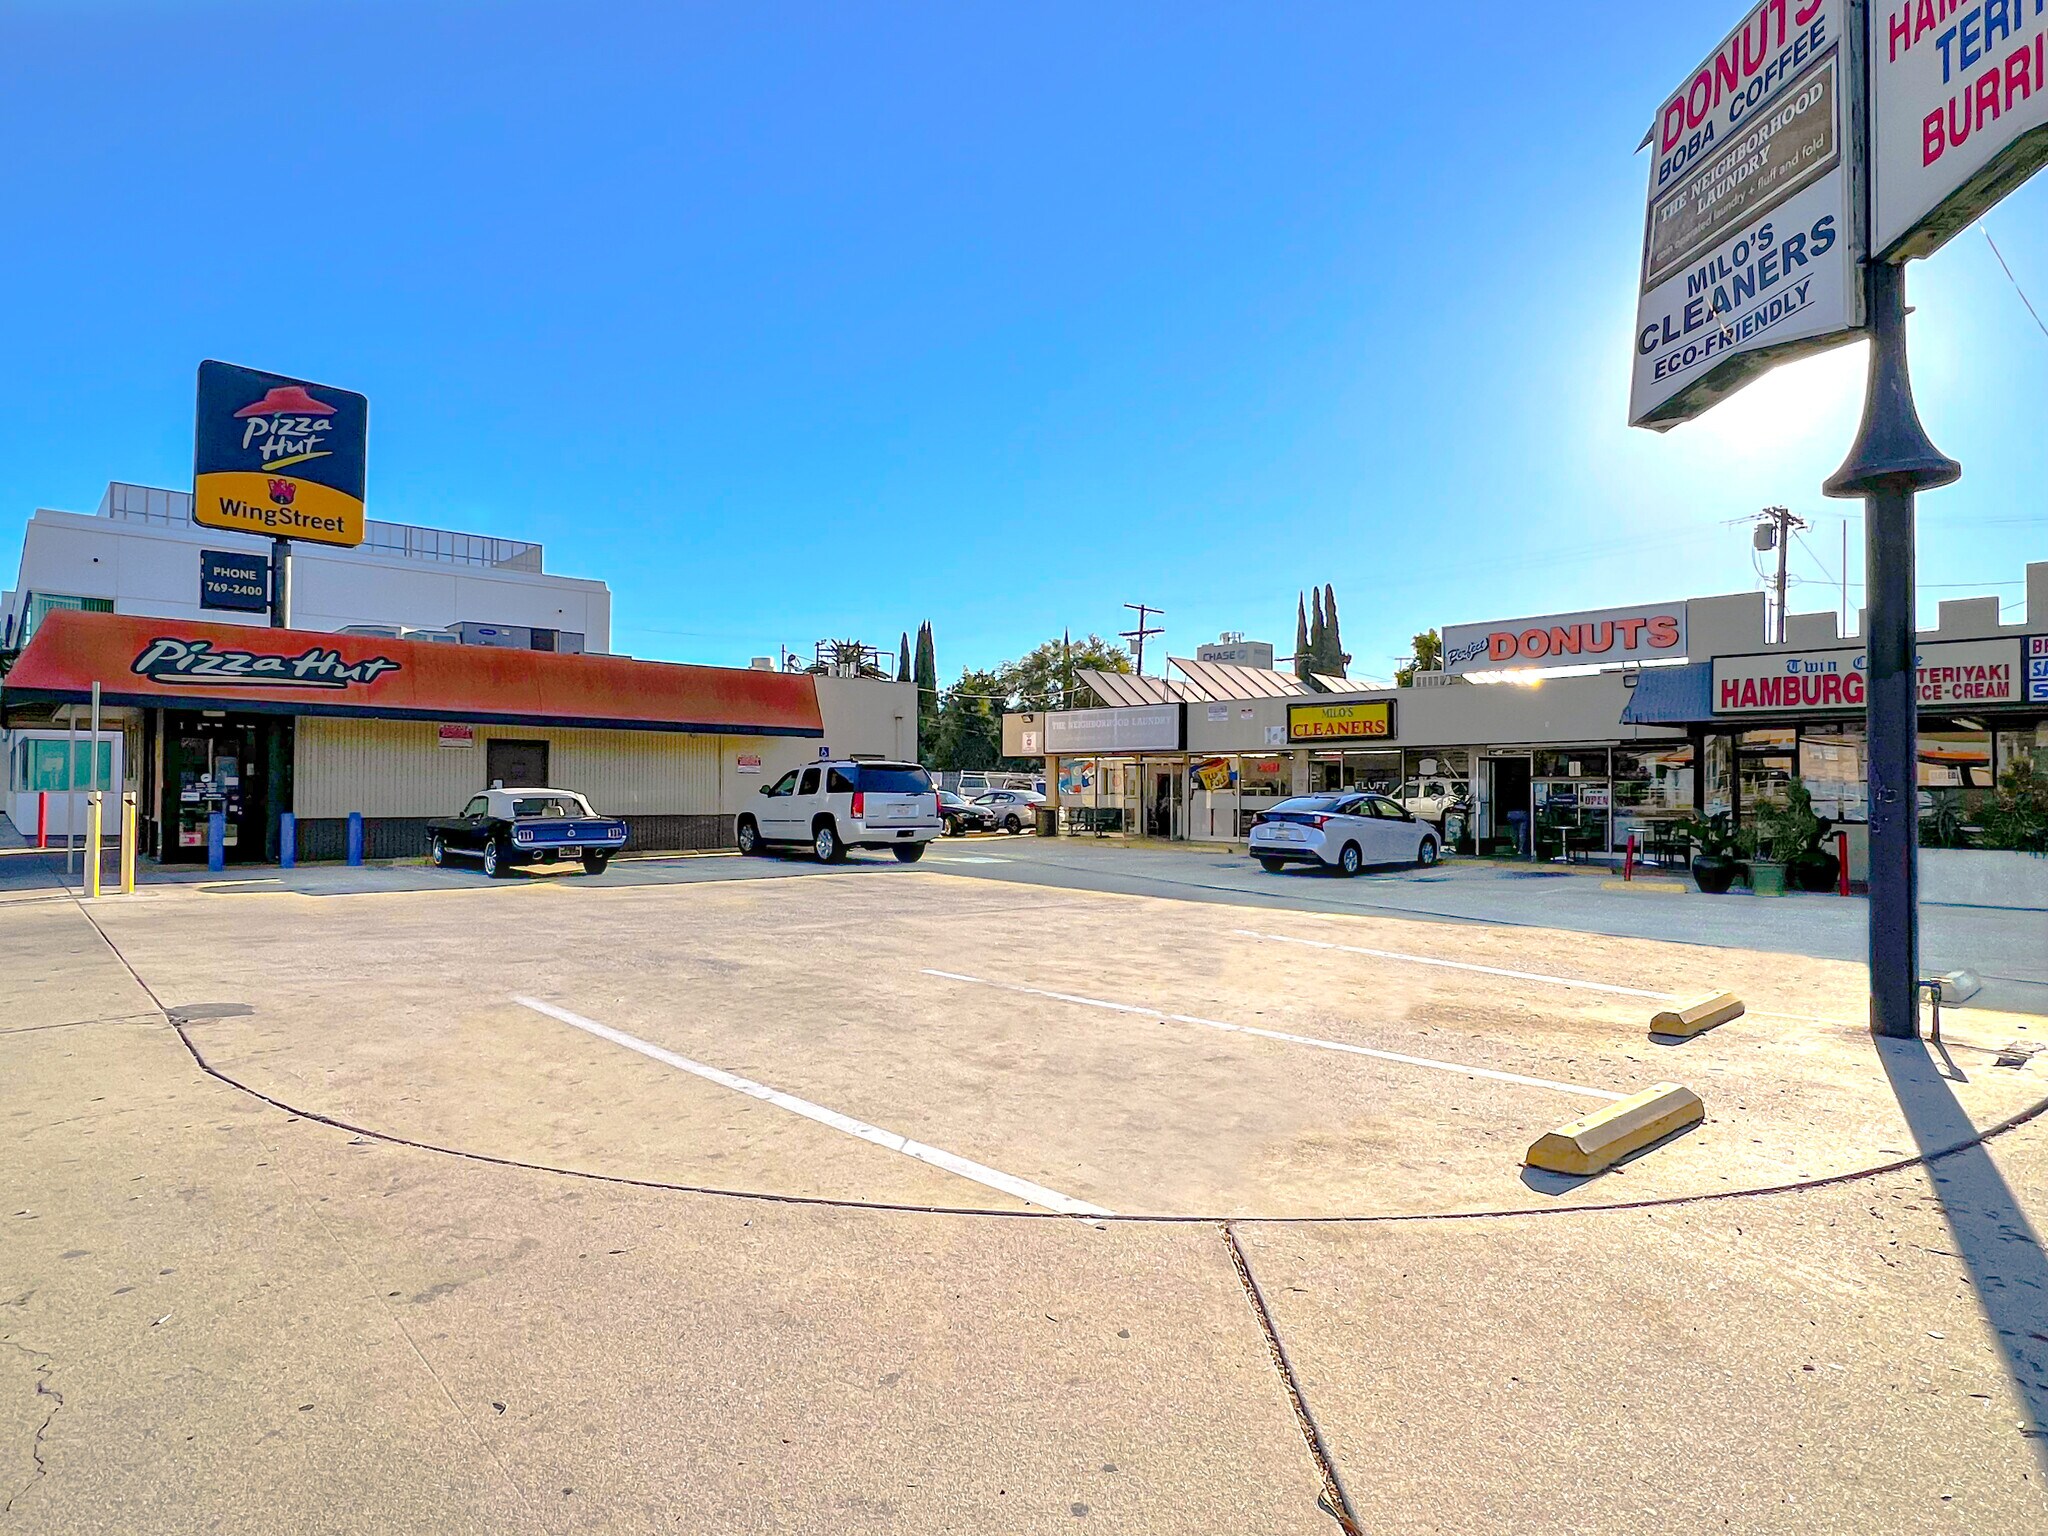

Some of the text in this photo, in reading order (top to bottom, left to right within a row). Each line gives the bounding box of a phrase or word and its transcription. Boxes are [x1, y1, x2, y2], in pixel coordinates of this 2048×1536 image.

[1658, 14, 1825, 186] BOBA COFFEE
[1923, 28, 2048, 168] BURRI
[1661, 82, 1824, 223] THE NEIGHBORHOOD
[1697, 144, 1771, 215] LAUNDRY
[1714, 190, 1746, 221] laundry
[1758, 165, 1778, 191] fluff
[1779, 150, 1799, 176] and
[1801, 132, 1824, 160] fold
[1687, 222, 1774, 299] MILO'S
[1638, 214, 1836, 356] CLEANERS
[1654, 279, 1811, 380] ECO-FRIENDLY
[242, 412, 333, 449] Pizza
[259, 435, 325, 461] Hut
[219, 497, 345, 534] WingStreet
[206, 581, 263, 596] 769-2400
[213, 566, 257, 580] PHONE
[1202, 650, 1236, 662] CHASE
[1488, 615, 1680, 662] DONUTS
[135, 640, 399, 681] Pizza Hut
[1786, 657, 1837, 674] Twin
[1917, 663, 2010, 684] TERIYAKI
[1720, 671, 1865, 709] HAMBURG
[1916, 681, 2010, 701] ICE-CREAM
[1052, 715, 1172, 731] THE NEIGHBORHOOD LAUNDRY
[1293, 719, 1386, 737] CLEANERS
[1355, 780, 1390, 791] FLUFF
[1584, 795, 1609, 806] OPEN
